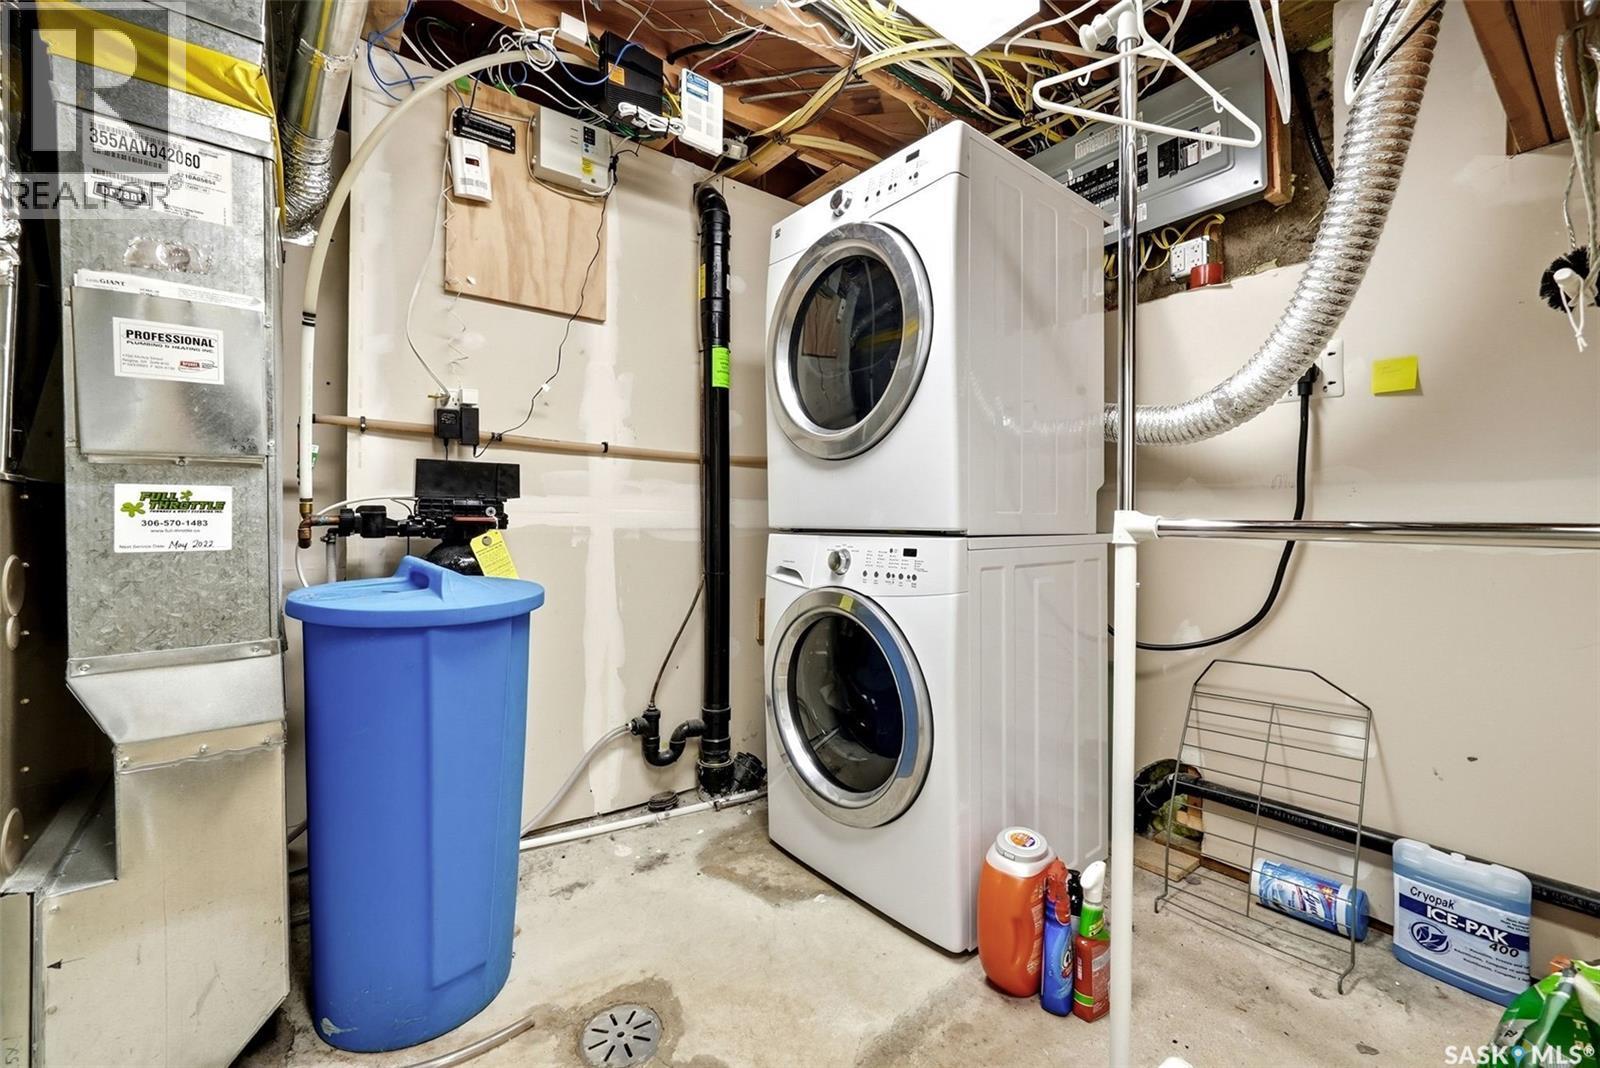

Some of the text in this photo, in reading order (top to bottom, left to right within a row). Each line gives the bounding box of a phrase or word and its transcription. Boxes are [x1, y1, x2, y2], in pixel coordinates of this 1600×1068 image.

[89, 126, 201, 169] 355AAV042060
[126, 329, 215, 348] PROFESSIONAL
[126, 340, 163, 348] PLUMBING
[139, 491, 178, 501] FULL
[149, 500, 226, 510] THROTTLE
[141, 519, 208, 527] 306-570-1483
[168, 538, 215, 550] May 2022
[1409, 886, 1456, 911] Cryopak
[1426, 905, 1509, 946] ICE-PAK
[1488, 942, 1520, 958] 400
